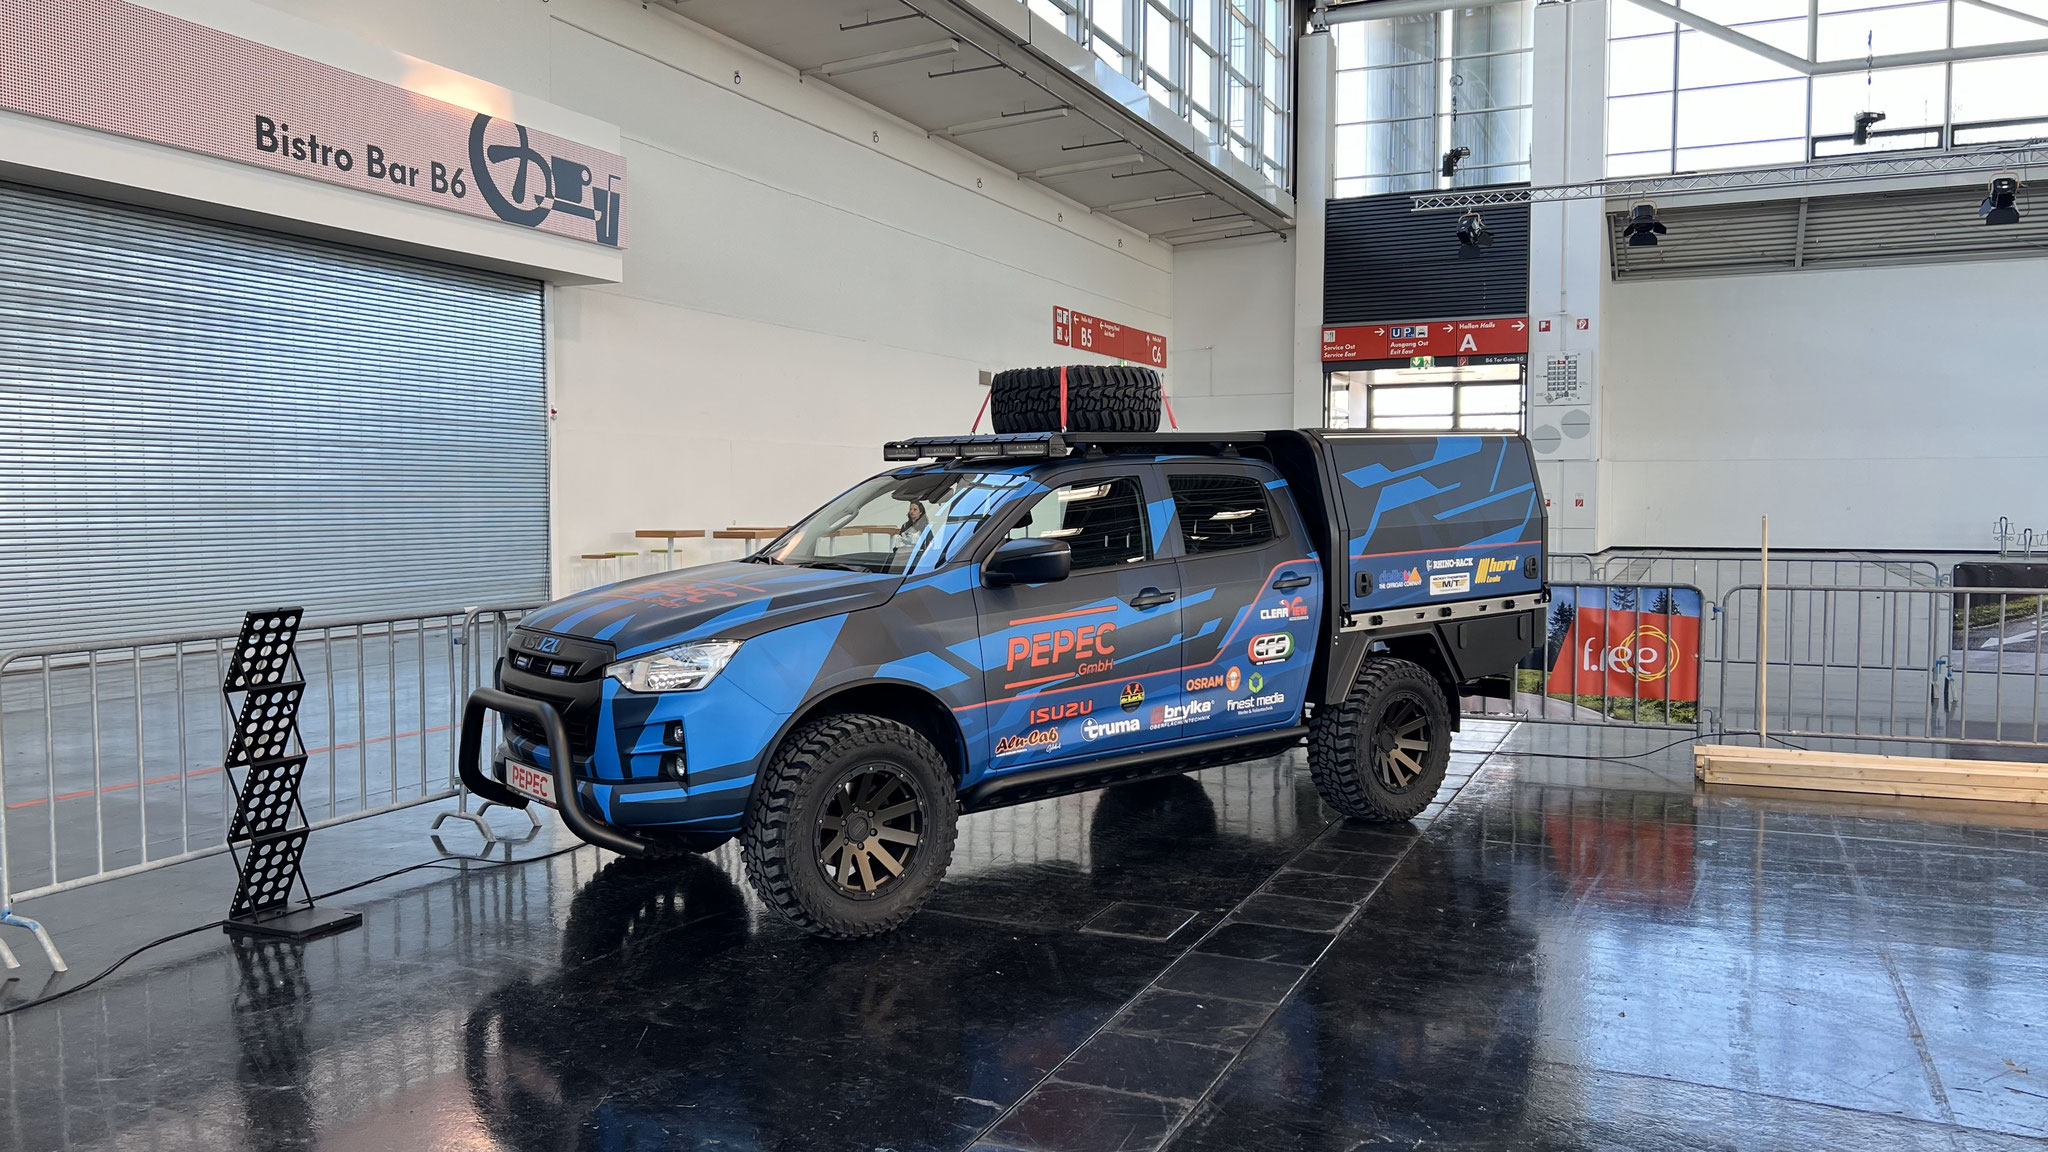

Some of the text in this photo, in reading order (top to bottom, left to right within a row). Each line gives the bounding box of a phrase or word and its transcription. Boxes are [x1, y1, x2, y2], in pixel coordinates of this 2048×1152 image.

[256, 114, 466, 198] Bistro Bar B6
[1081, 327, 1092, 348] B5
[1392, 328, 1400, 337] U
[1459, 333, 1477, 352] A
[1152, 345, 1162, 363] C6
[1489, 558, 1516, 573] horn
[1442, 579, 1460, 588] M/T
[524, 634, 562, 655] ISUZU
[1006, 622, 1117, 672] PEPEC
[1255, 636, 1286, 656] EFS
[1078, 658, 1114, 676] GmbH
[1186, 675, 1223, 691] OSRAM
[1164, 700, 1211, 718] brylka
[1227, 692, 1285, 711] finest media
[1030, 699, 1093, 725] ISUZU
[1084, 718, 1140, 739] truma
[995, 727, 1059, 753] Alu-Cab
[512, 765, 548, 797] PEPEC
